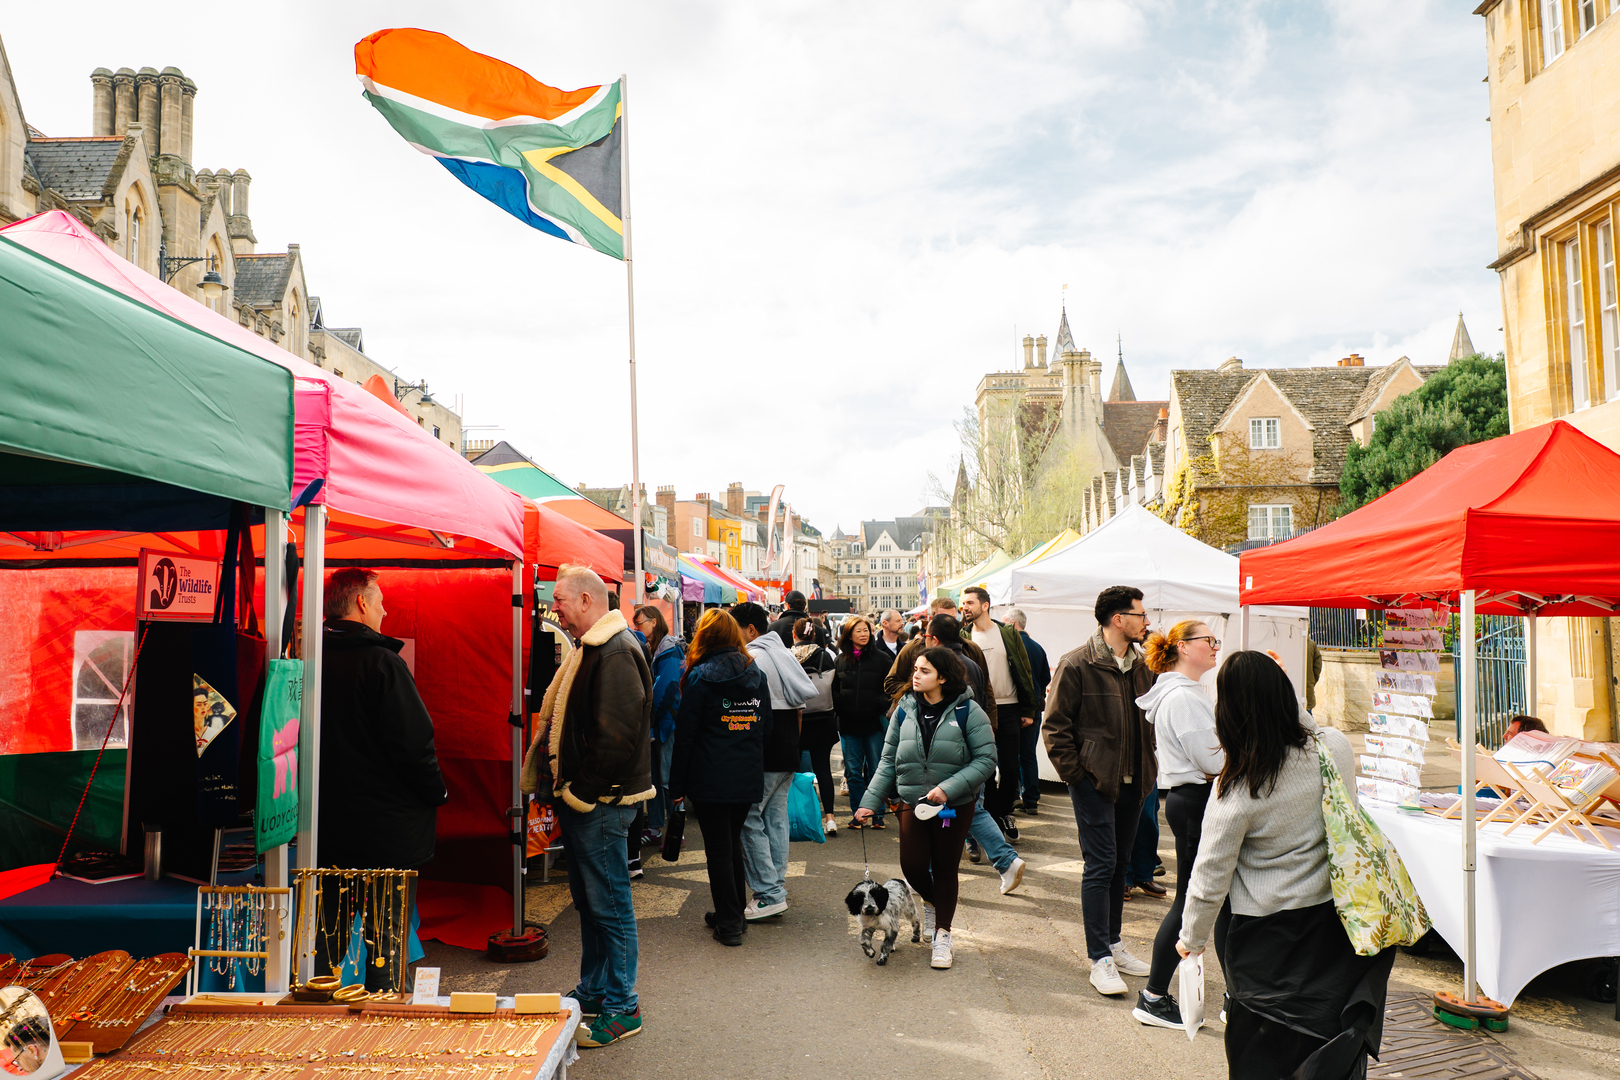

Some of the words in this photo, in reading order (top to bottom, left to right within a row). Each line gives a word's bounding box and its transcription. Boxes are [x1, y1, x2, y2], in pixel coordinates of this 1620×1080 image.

[180, 566, 191, 577] The
[179, 578, 212, 594] Wildlife
[178, 593, 196, 604] Trusts
[728, 722, 750, 730] Oxford
